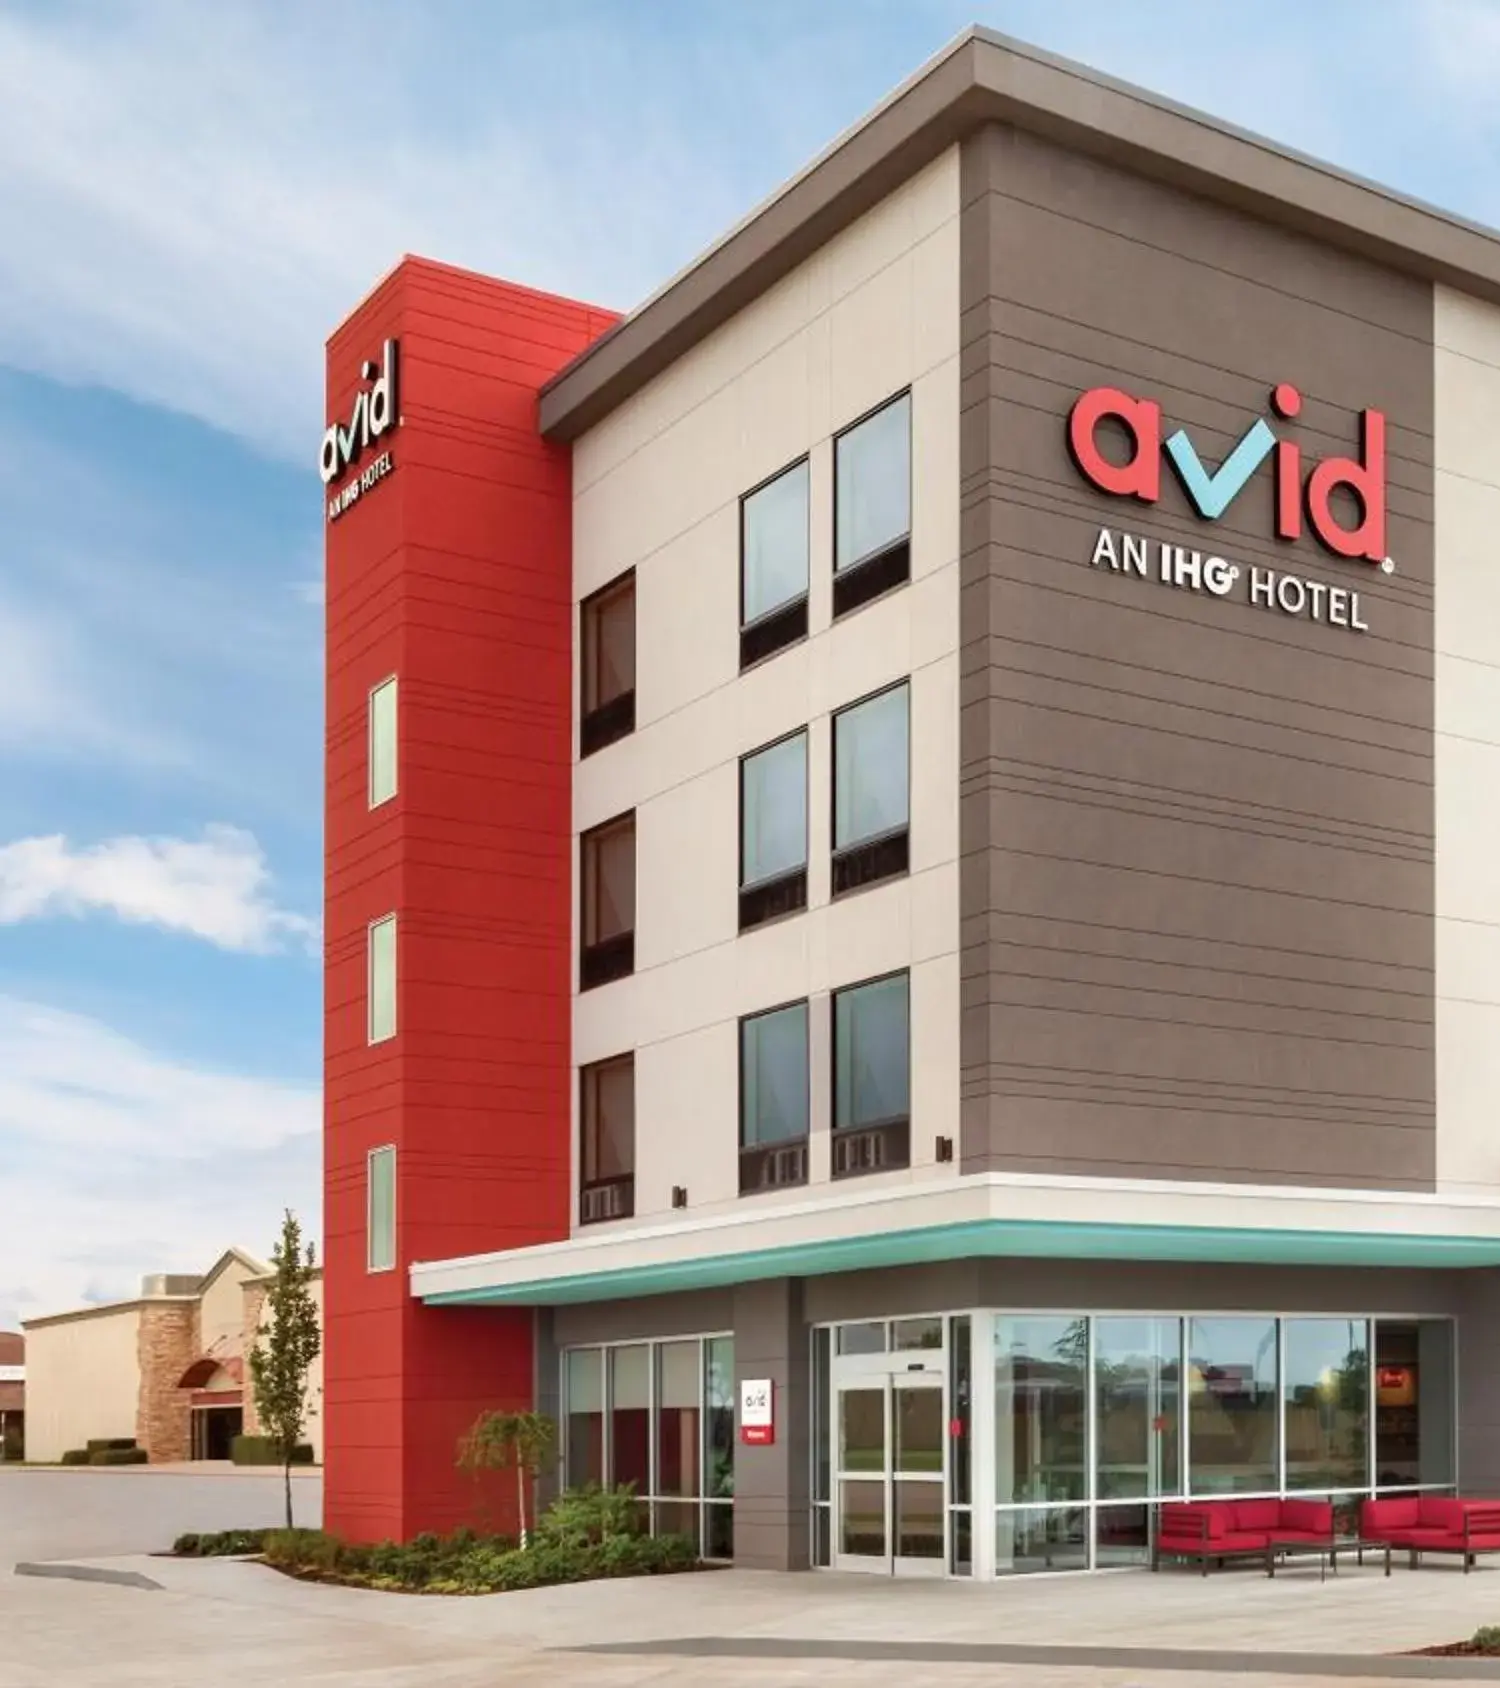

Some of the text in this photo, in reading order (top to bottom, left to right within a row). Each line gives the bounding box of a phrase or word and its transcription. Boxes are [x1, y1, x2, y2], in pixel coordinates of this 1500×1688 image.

[319, 337, 395, 483] avid
[361, 451, 392, 494] HOTEL
[1067, 383, 1386, 563] avid
[1092, 528, 1148, 576] AN
[1250, 566, 1369, 631] HOTEL
